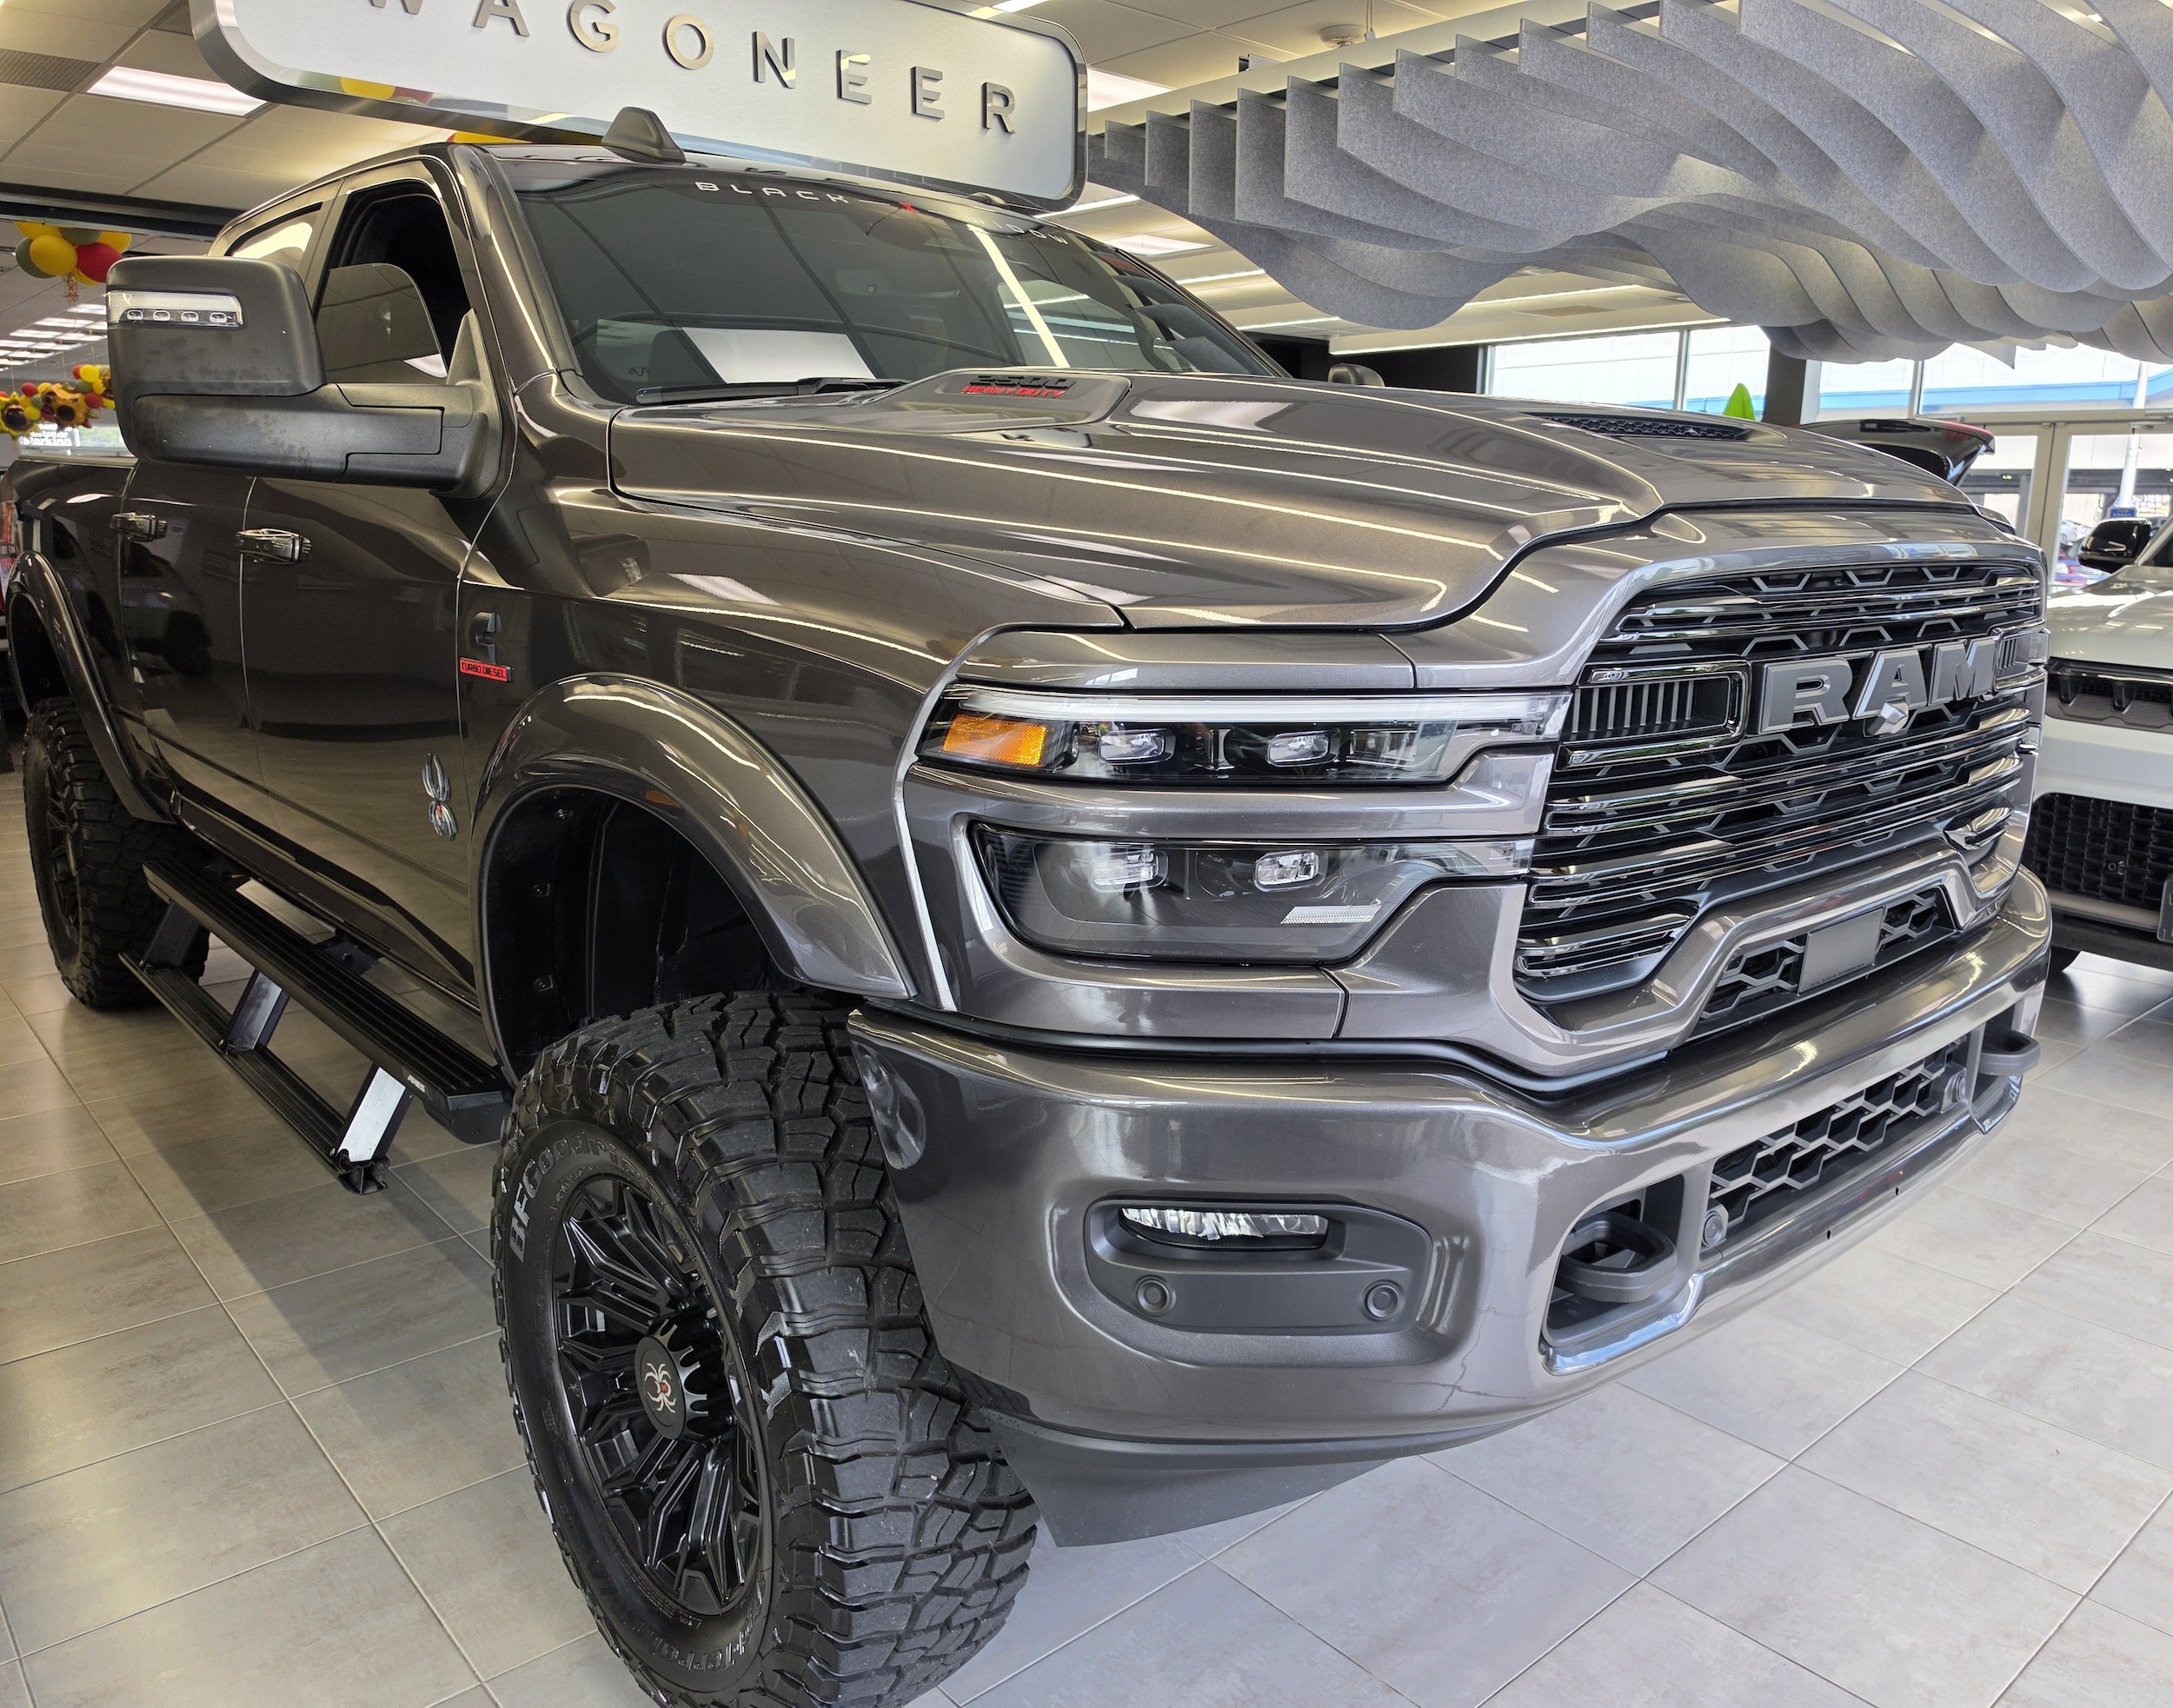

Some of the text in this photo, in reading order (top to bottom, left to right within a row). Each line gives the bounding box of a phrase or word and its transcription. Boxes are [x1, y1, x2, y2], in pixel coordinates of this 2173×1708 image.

[369, 0, 1017, 136] AGONEER
[694, 181, 1068, 245] BLACK WIDOW
[961, 385, 1067, 399] HEAVY DUTY
[970, 375, 1076, 390] 2500
[462, 661, 506, 679] TURBO DIESEL
[1758, 637, 1997, 735] RAM
